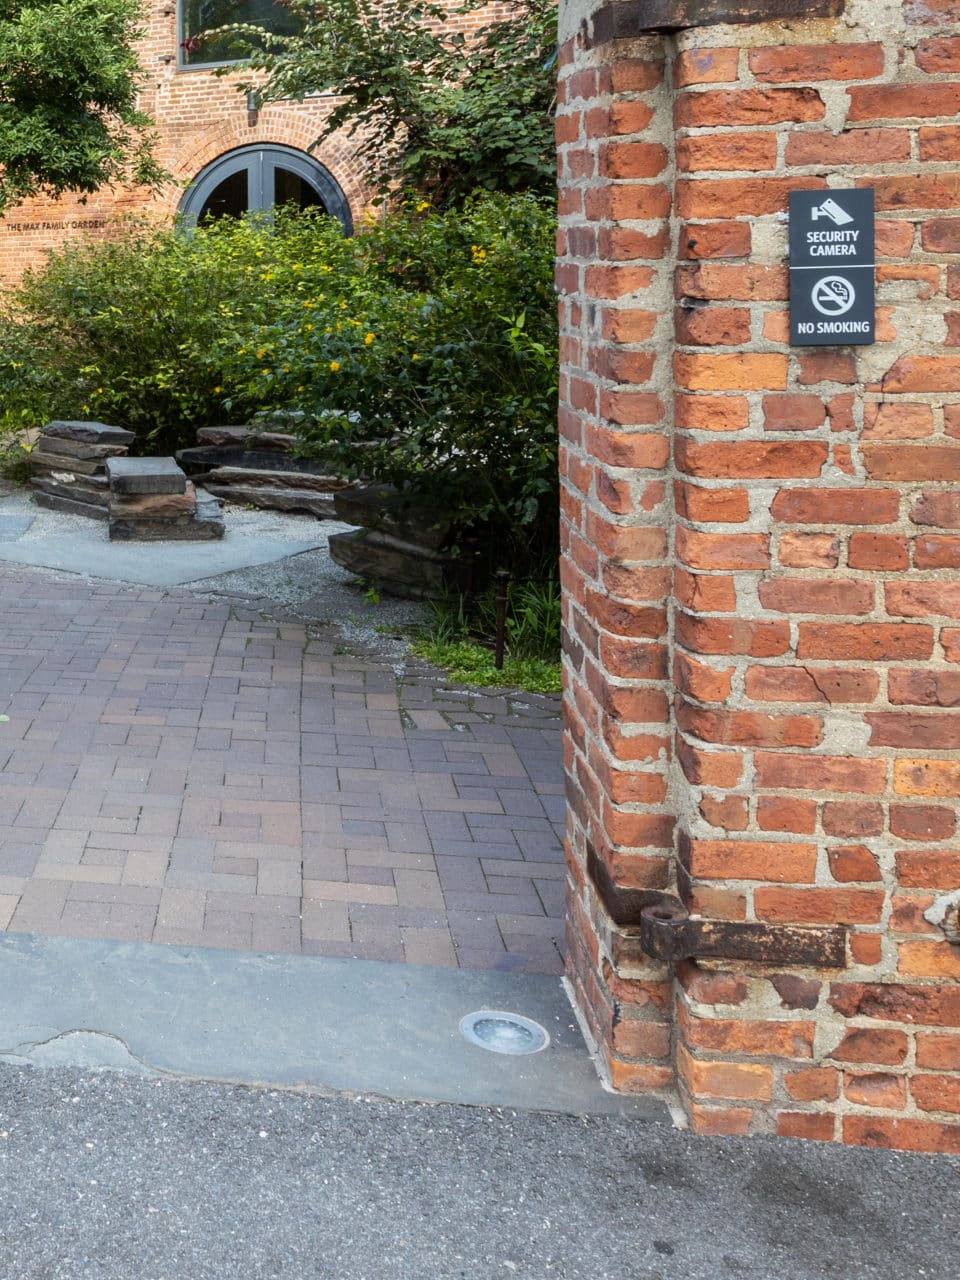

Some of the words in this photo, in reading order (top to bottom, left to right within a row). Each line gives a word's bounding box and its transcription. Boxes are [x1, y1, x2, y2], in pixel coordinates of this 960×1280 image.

[6, 223, 21, 232] THE
[42, 221, 69, 230] FAMILY
[71, 220, 106, 229] GARDEN
[806, 230, 860, 243] SECURITY
[809, 244, 857, 257] CAMERA
[797, 322, 815, 334] NO
[816, 320, 870, 334] SMOKING
